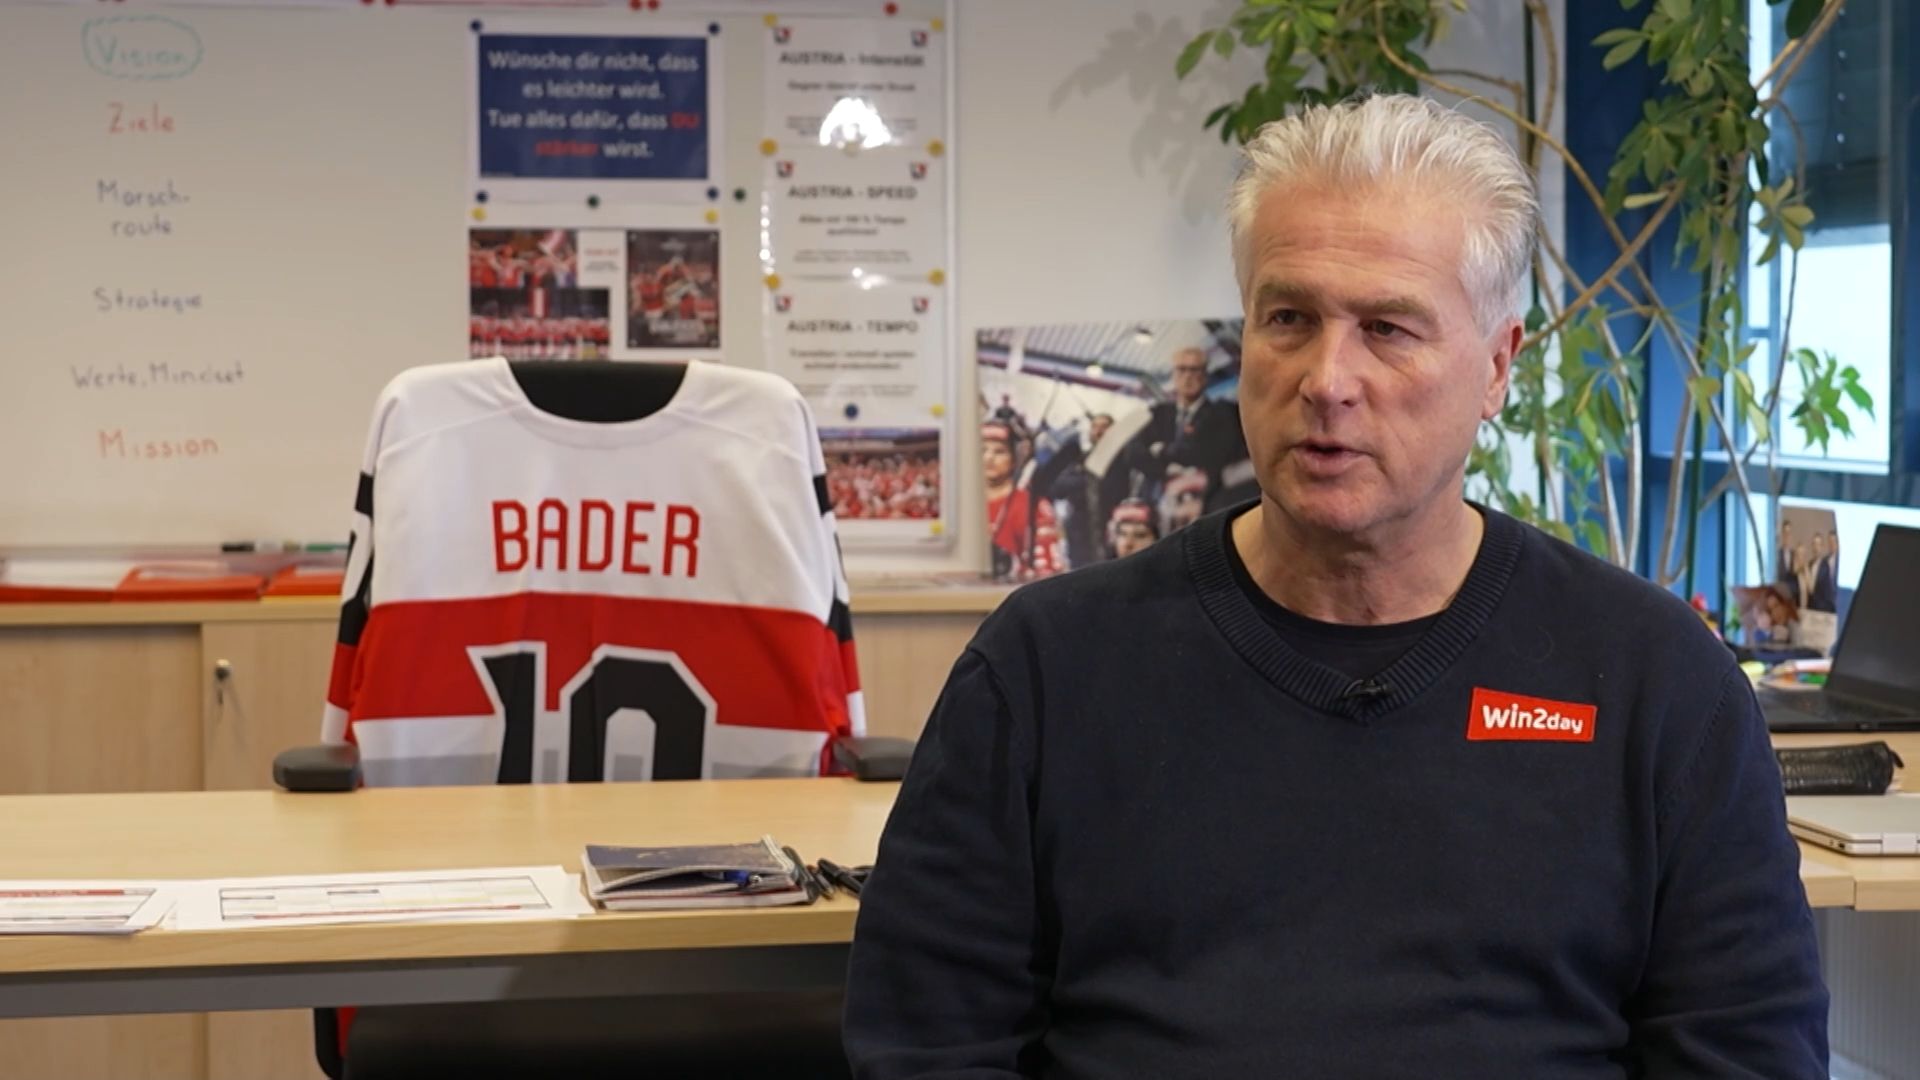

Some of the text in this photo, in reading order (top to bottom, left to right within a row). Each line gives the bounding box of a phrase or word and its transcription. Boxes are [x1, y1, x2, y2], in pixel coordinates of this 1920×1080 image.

[95, 35, 186, 66] Vision
[488, 51, 699, 72] Wünsche dir nicht, dass
[780, 52, 846, 65] AUSTRIA
[522, 80, 665, 99] es leichter wird.
[107, 101, 175, 134] Ziele
[488, 109, 522, 128] Tue
[525, 109, 566, 128] alles
[570, 110, 624, 131] dafür,
[627, 111, 668, 130] dass
[602, 140, 653, 158] wirst.
[788, 185, 854, 199] AUSTRIA
[868, 186, 918, 199] SPEED
[112, 211, 173, 237] route
[94, 285, 202, 313] Strategie
[787, 320, 853, 333] AUSTRIA
[868, 320, 919, 333] TEMPO
[98, 428, 219, 459] Mission
[491, 498, 700, 578] BADER
[465, 640, 718, 785] 10
[1482, 703, 1584, 735] Win2day
